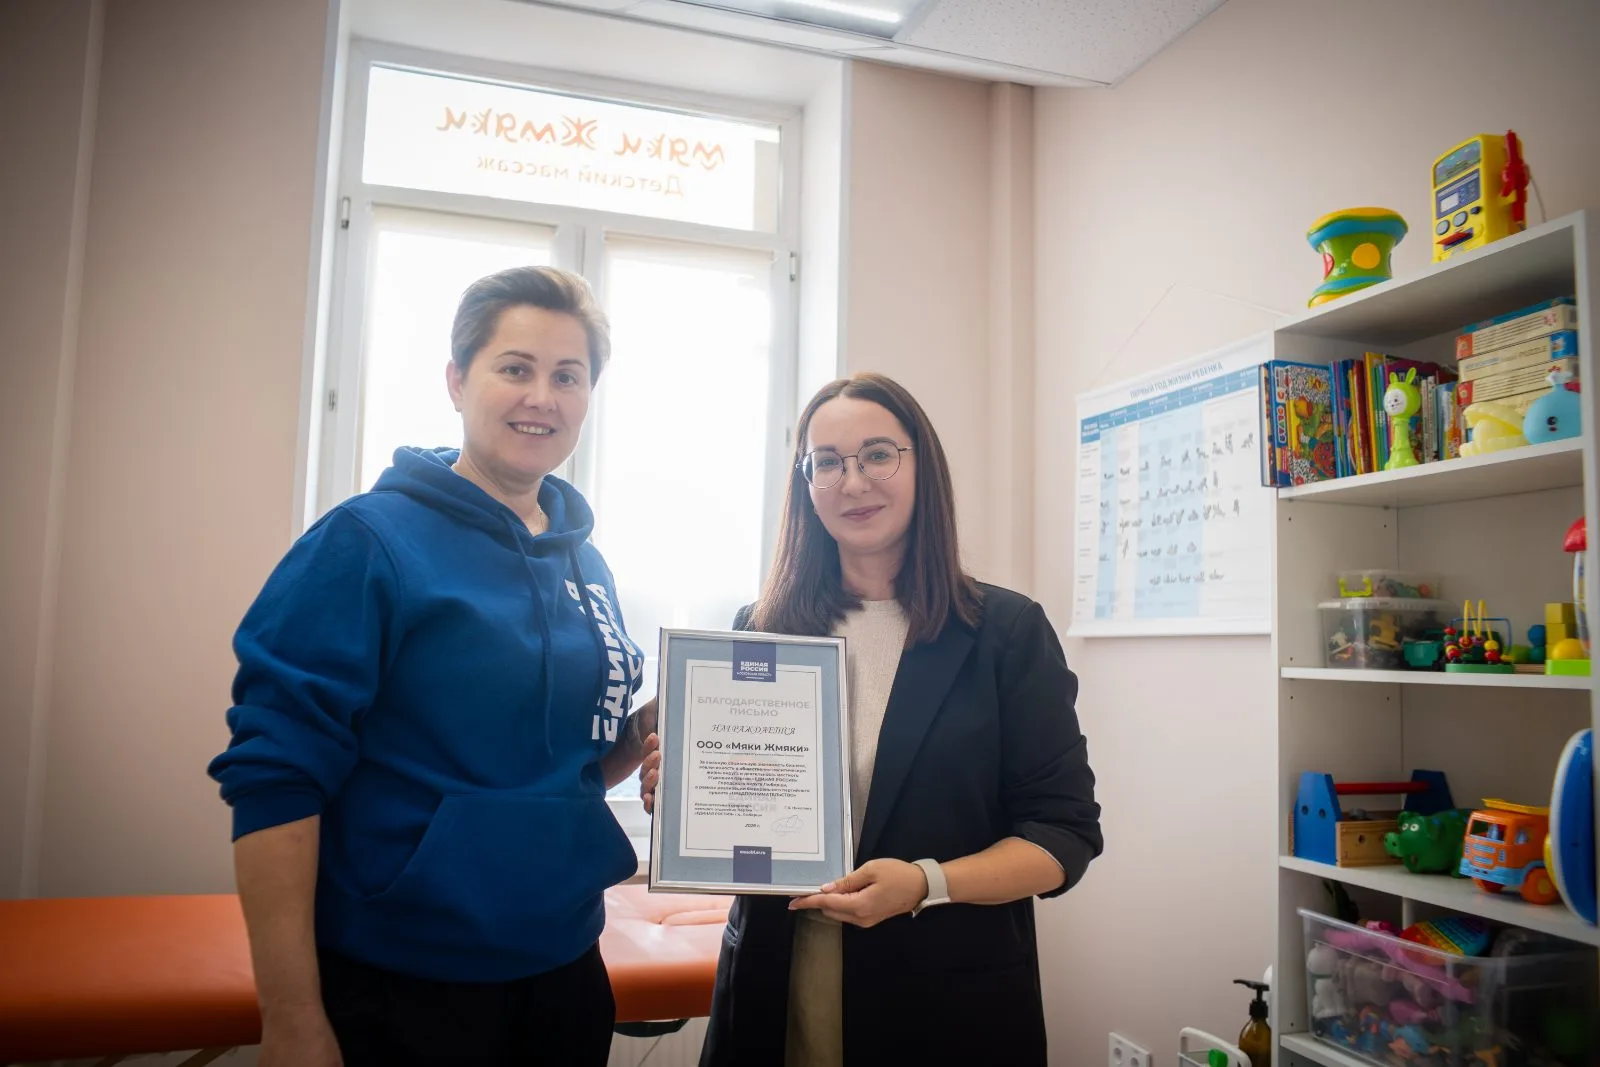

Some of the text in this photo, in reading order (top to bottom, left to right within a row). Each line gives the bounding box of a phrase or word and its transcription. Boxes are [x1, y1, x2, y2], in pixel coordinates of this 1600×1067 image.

[698, 696, 810, 709] БЛАГОДАРСТВЕННОЕ
[730, 708, 778, 717] ПИСЬМО
[712, 724, 796, 735] НАГРАЖДАЕТСЯ
[696, 740, 809, 752] ООО «Мяки Жмяки»
